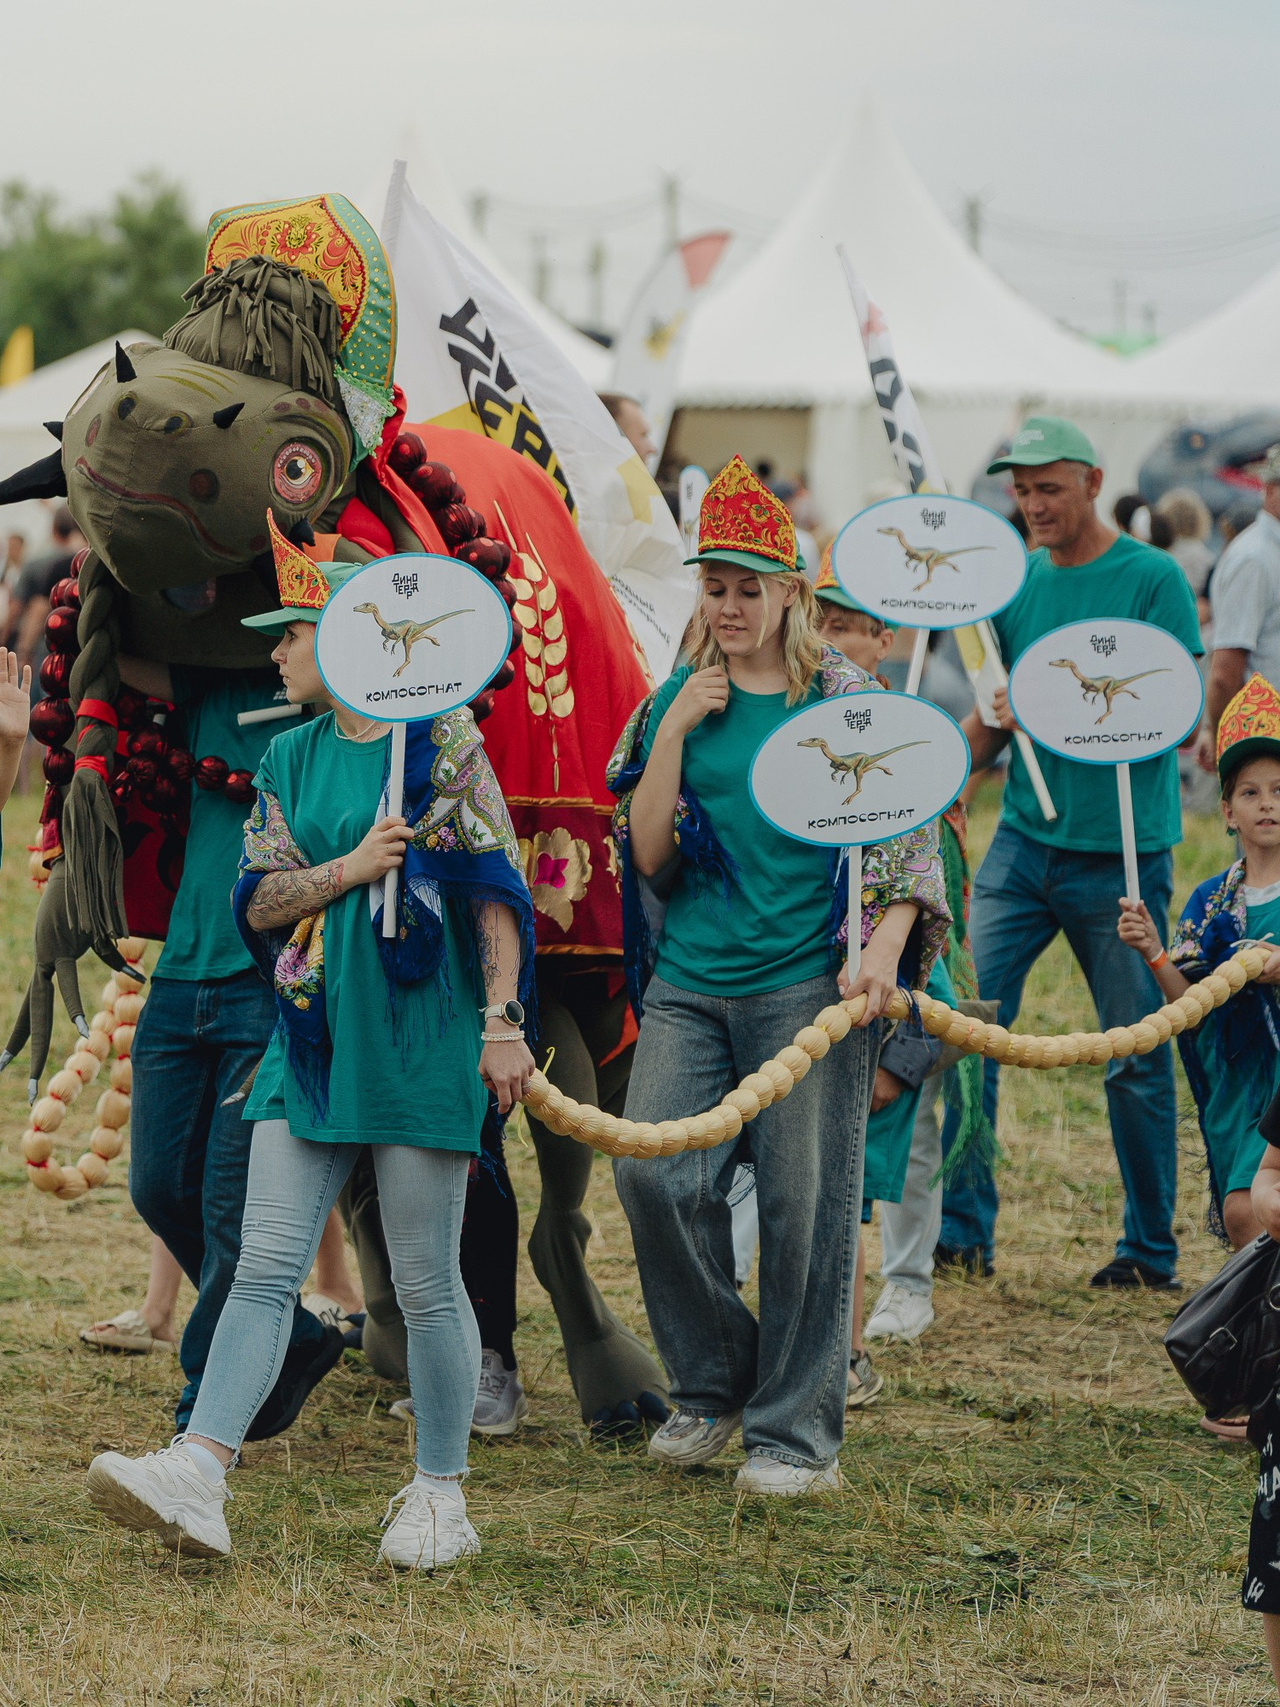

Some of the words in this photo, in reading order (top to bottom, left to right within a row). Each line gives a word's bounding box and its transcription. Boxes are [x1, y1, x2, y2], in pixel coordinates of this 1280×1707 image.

[391, 572, 418, 585] ДИНО
[881, 598, 978, 612] КОМПОСОГНАТ
[1089, 634, 1117, 645] ДИНО
[365, 681, 463, 703] КОМПОСОГНАТ
[843, 708, 872, 721] ДИНО
[1064, 731, 1163, 745] КОМПОСОГНАТ
[807, 808, 915, 830] КОМПОСОГНАТ
